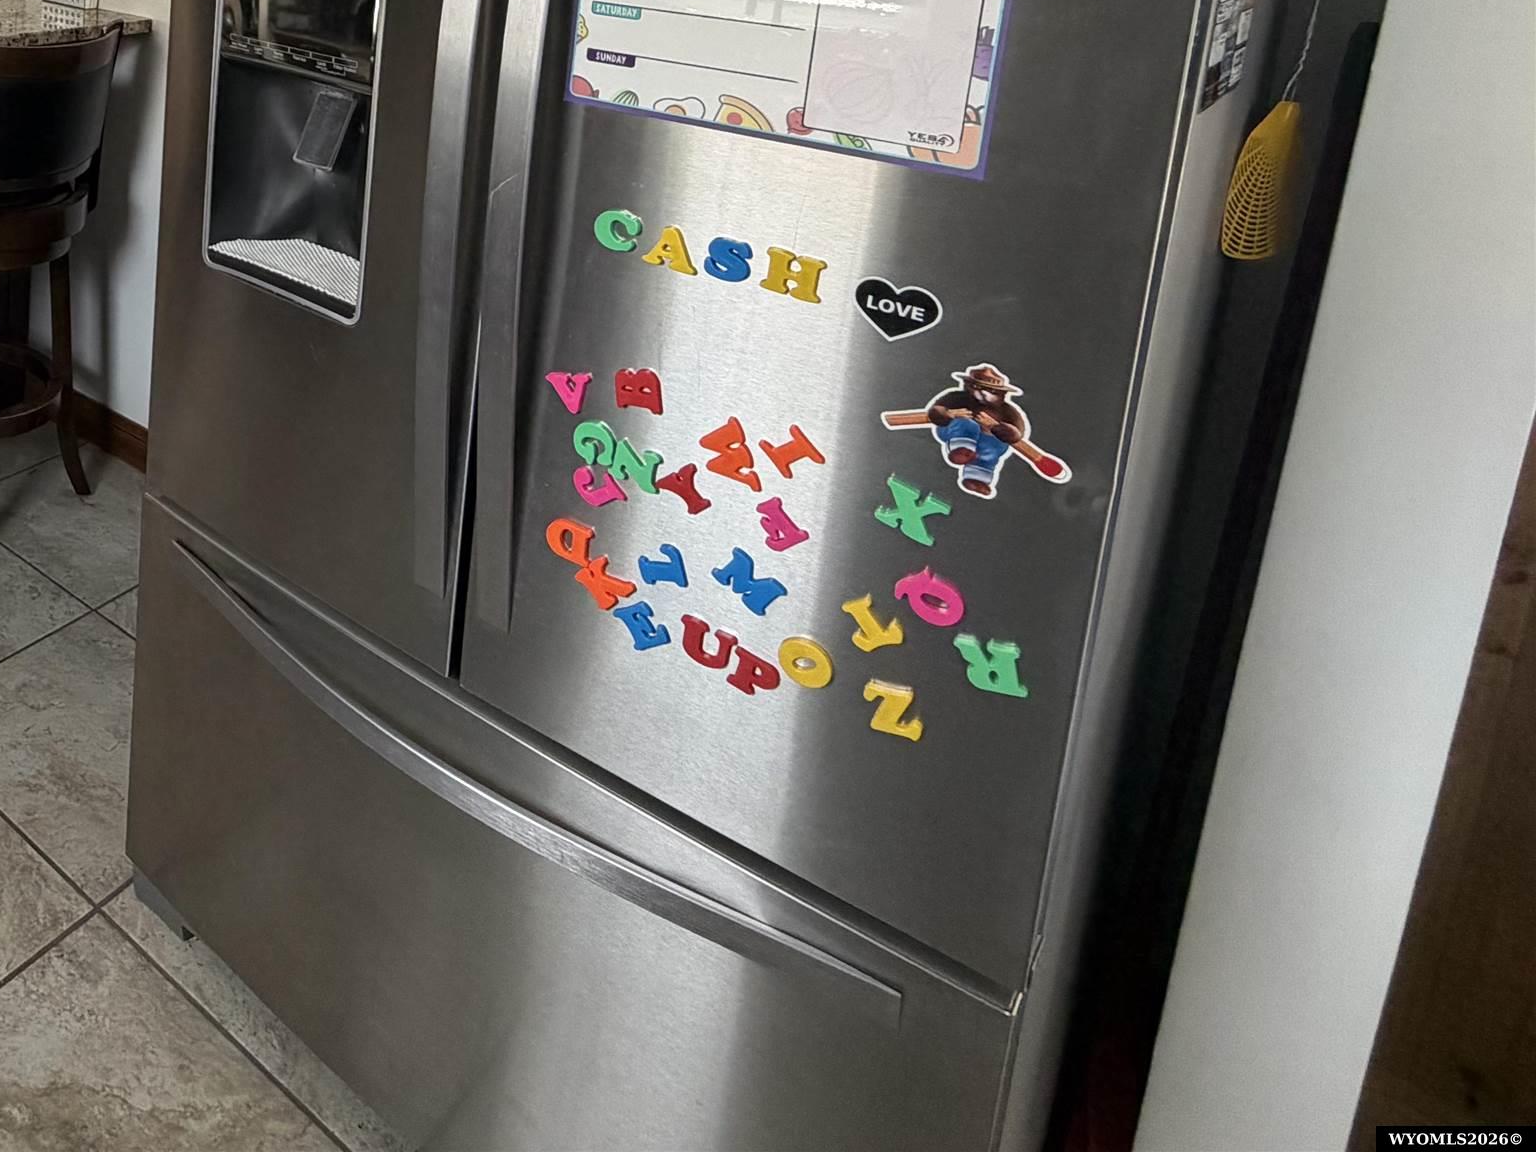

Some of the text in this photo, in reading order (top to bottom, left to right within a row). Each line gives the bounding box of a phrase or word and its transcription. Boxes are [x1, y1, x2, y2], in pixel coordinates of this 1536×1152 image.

[596, 4, 638, 18] SATURDAY
[595, 51, 627, 65] SUNDAY
[593, 208, 827, 304] CASH
[865, 294, 926, 323] LOVE
